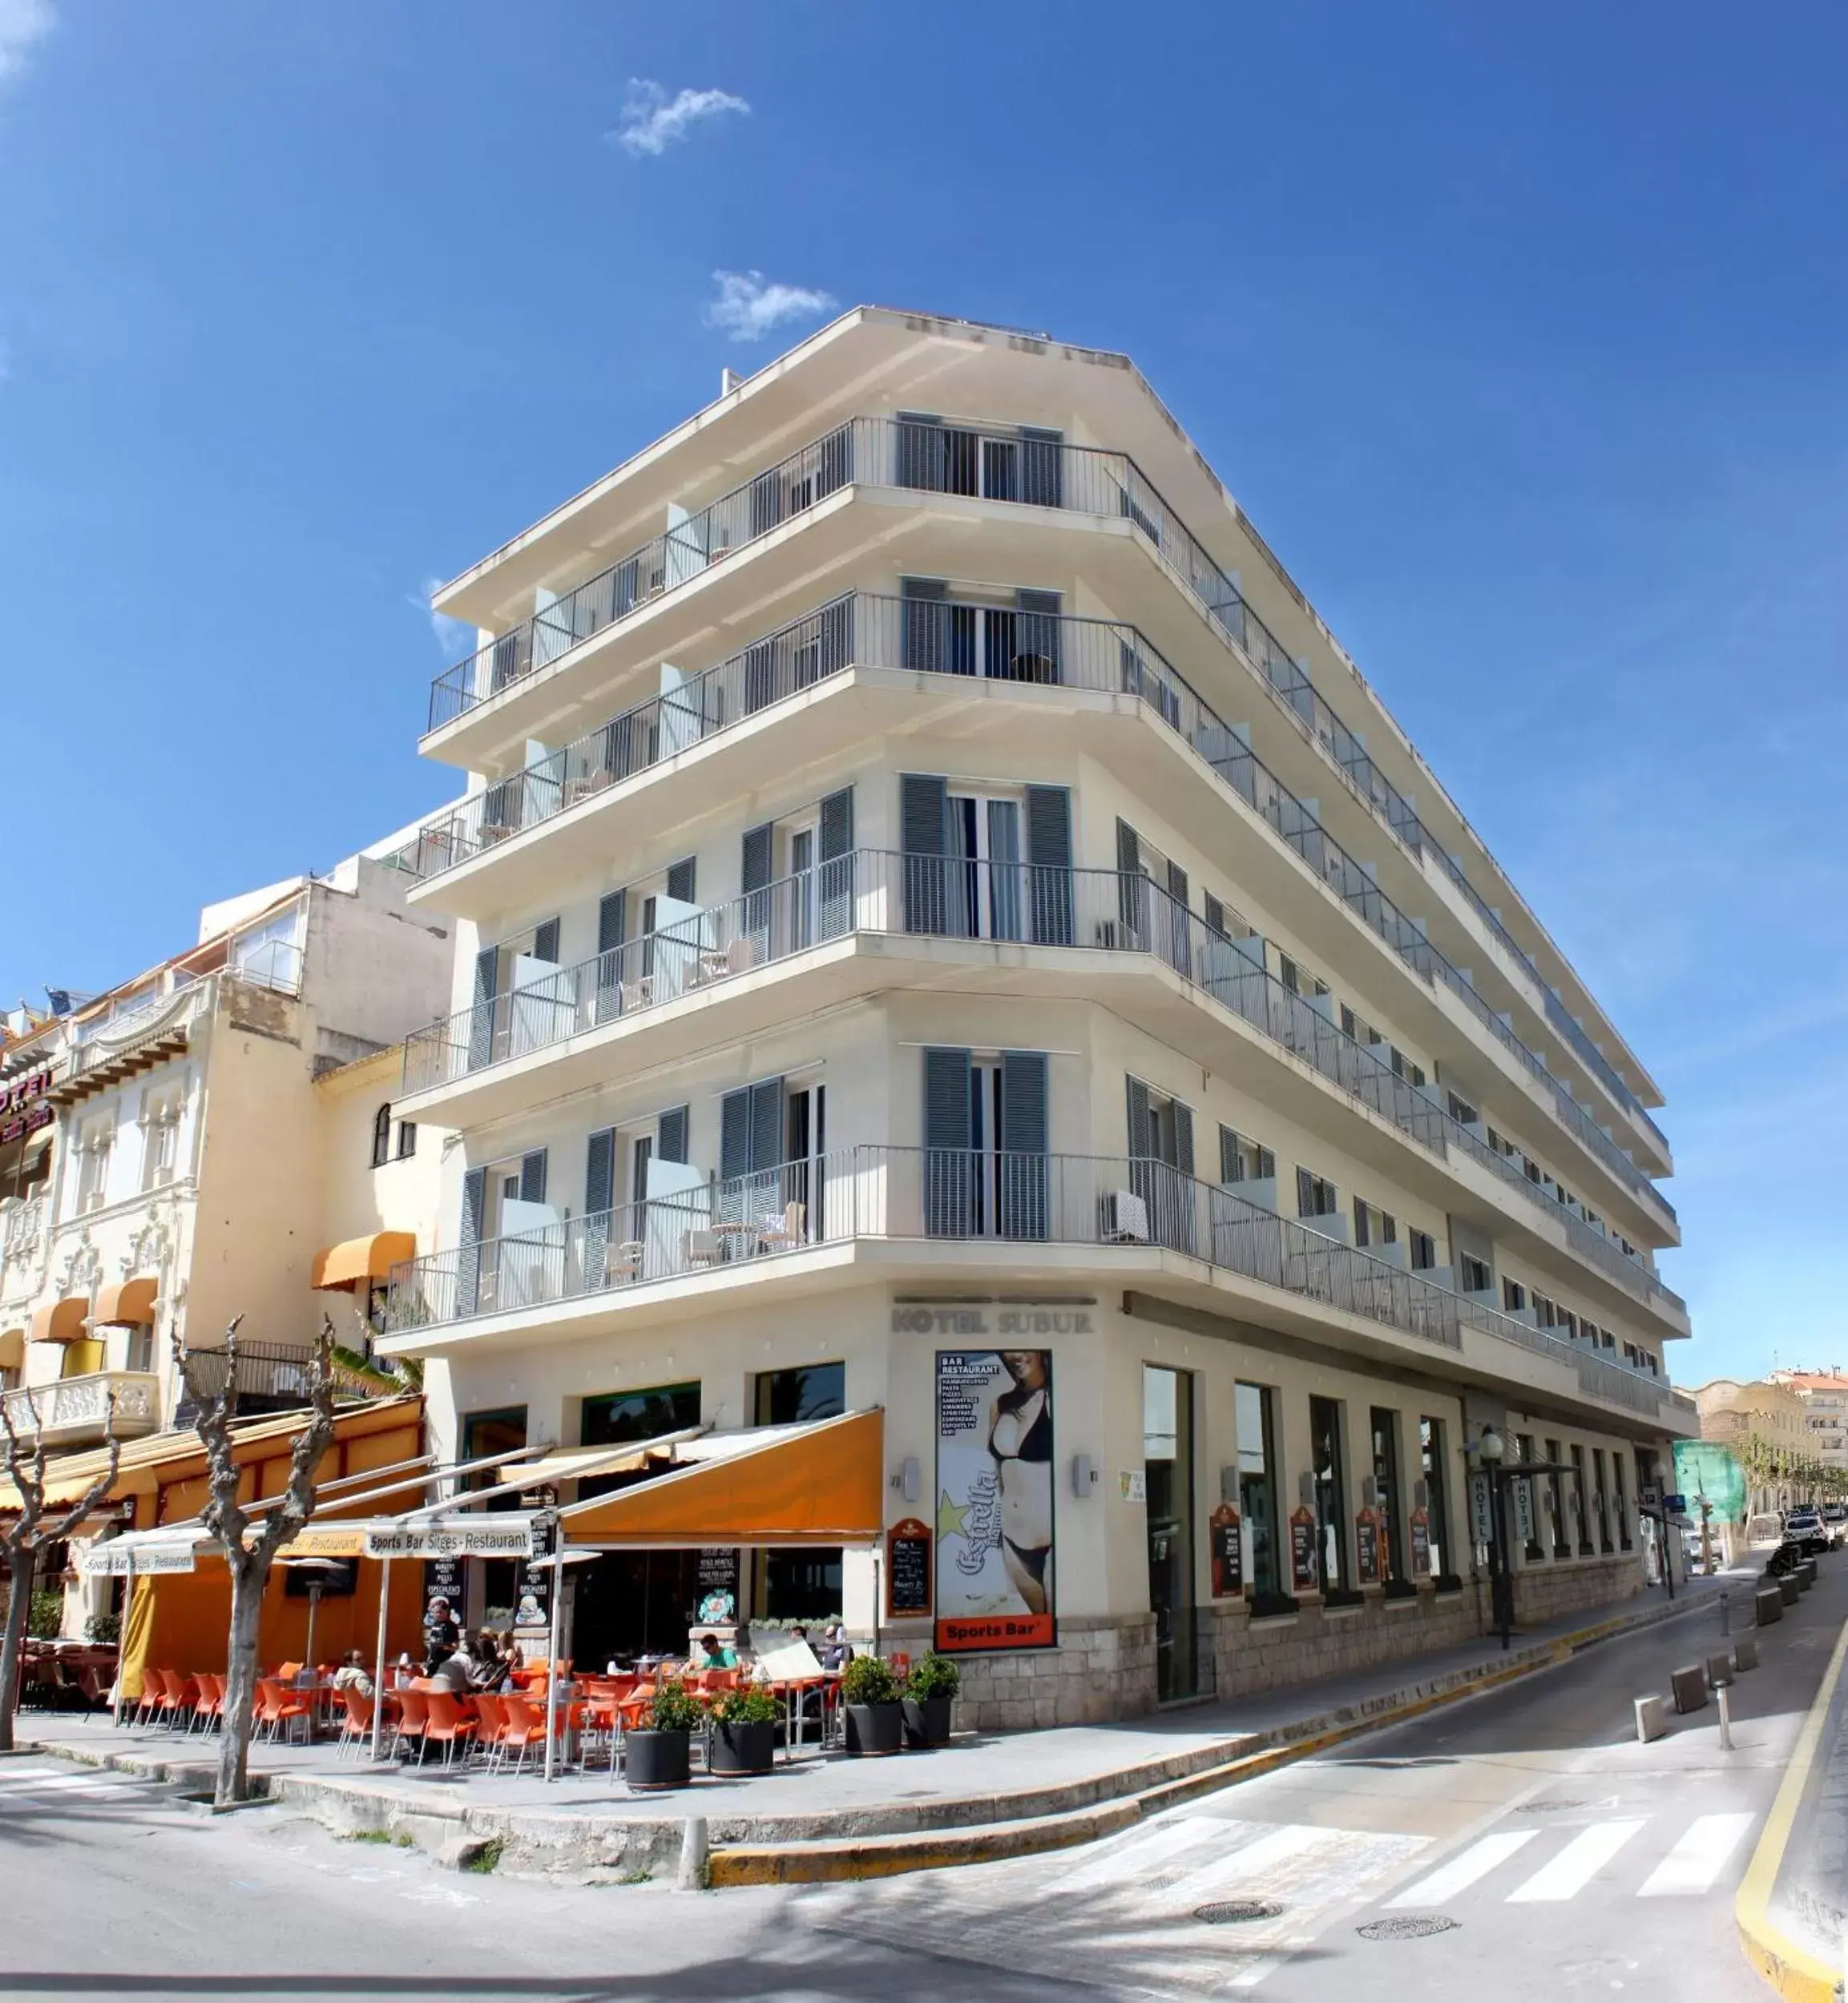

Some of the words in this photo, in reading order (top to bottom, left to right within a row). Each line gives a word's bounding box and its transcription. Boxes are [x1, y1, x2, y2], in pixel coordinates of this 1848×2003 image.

[998, 1311, 1095, 1334] SUBUR
[942, 1358, 962, 1366] BAR
[942, 1366, 998, 1374] RESTAURANT
[1475, 1482, 1487, 1537] HOTEL
[370, 1536, 401, 1552] Sports
[406, 1534, 424, 1549] Bar
[428, 1533, 458, 1553] Sitges
[466, 1533, 527, 1549] Restaurant
[946, 1624, 1001, 1641] Sports
[1005, 1622, 1035, 1636] Bar
